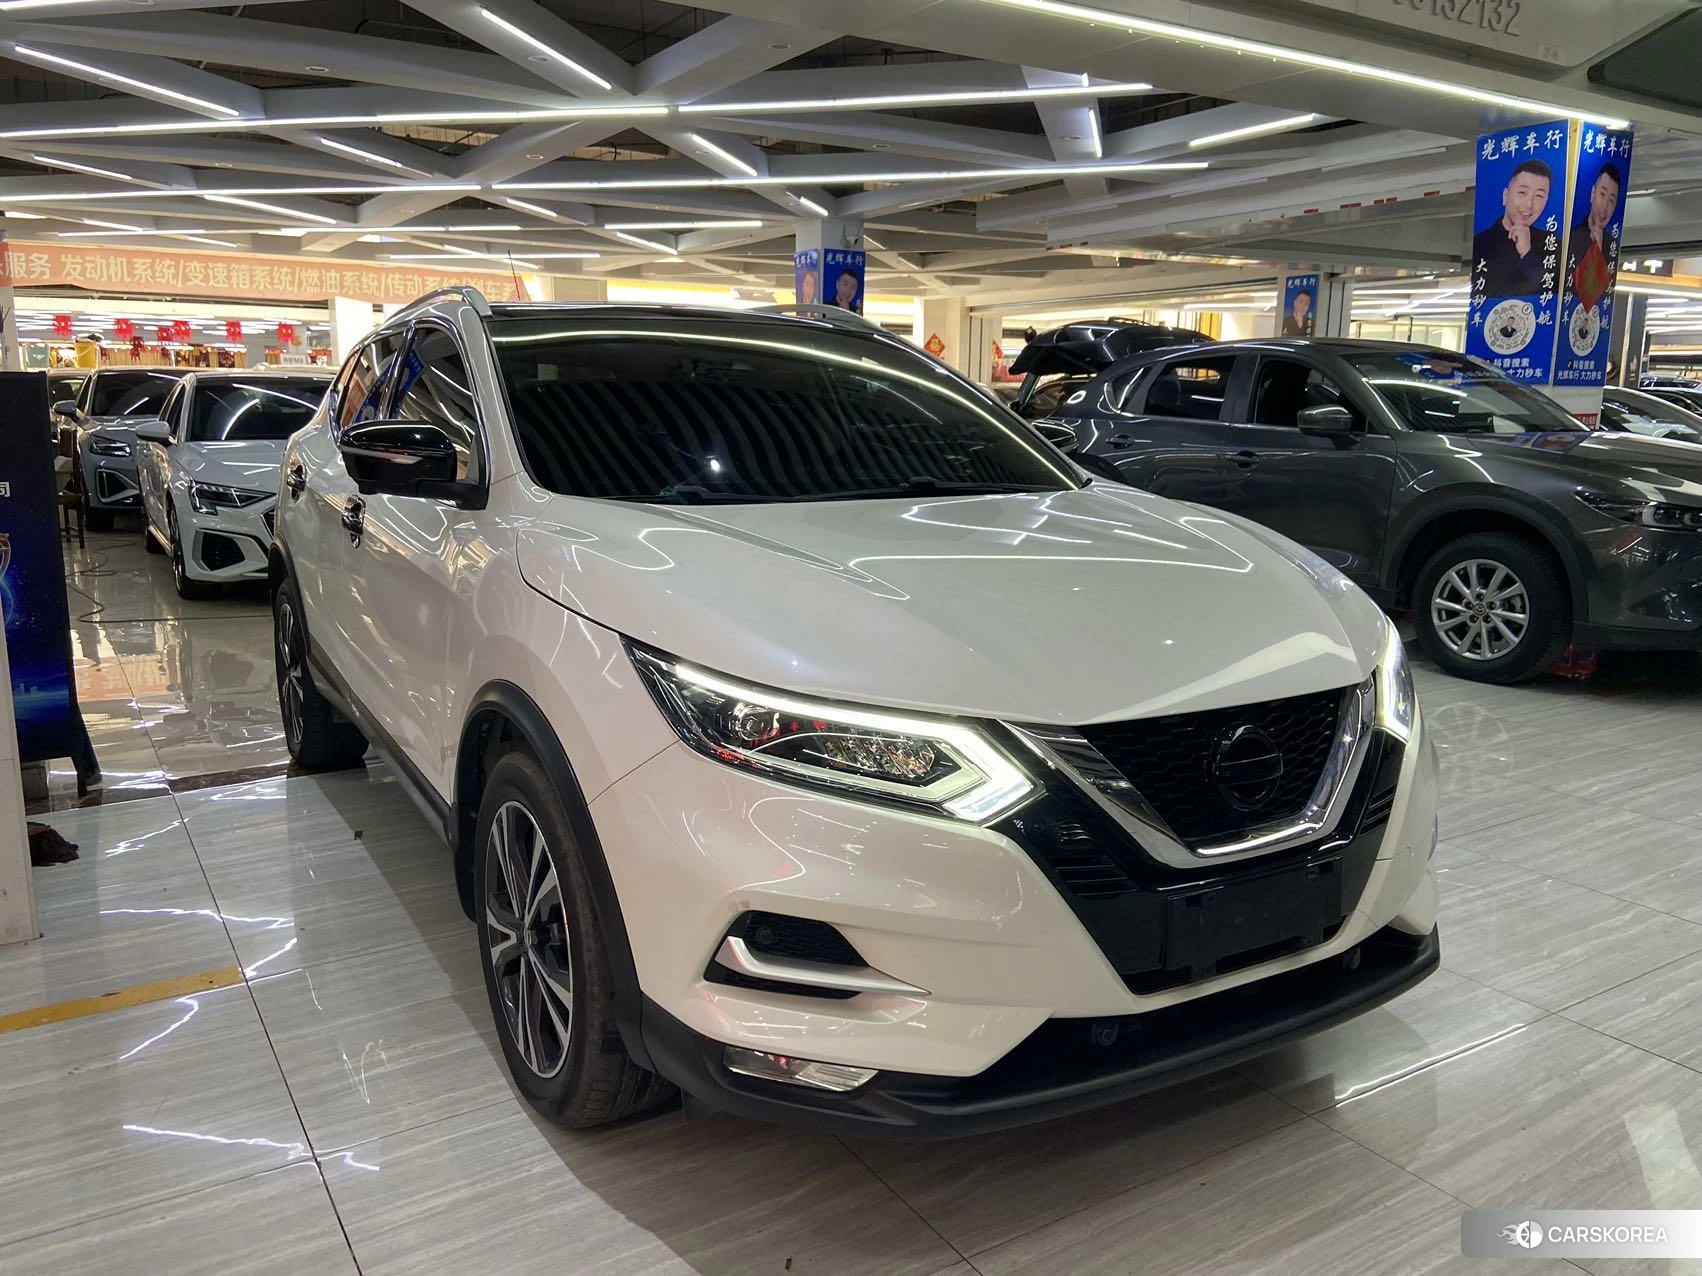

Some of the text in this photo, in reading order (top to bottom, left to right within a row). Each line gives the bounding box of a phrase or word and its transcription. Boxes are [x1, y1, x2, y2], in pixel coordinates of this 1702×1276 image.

[1481, 129, 1563, 160] 光辉车行
[1583, 129, 1631, 159] 光辉车行
[1536, 214, 1558, 325] 为您保驾护航
